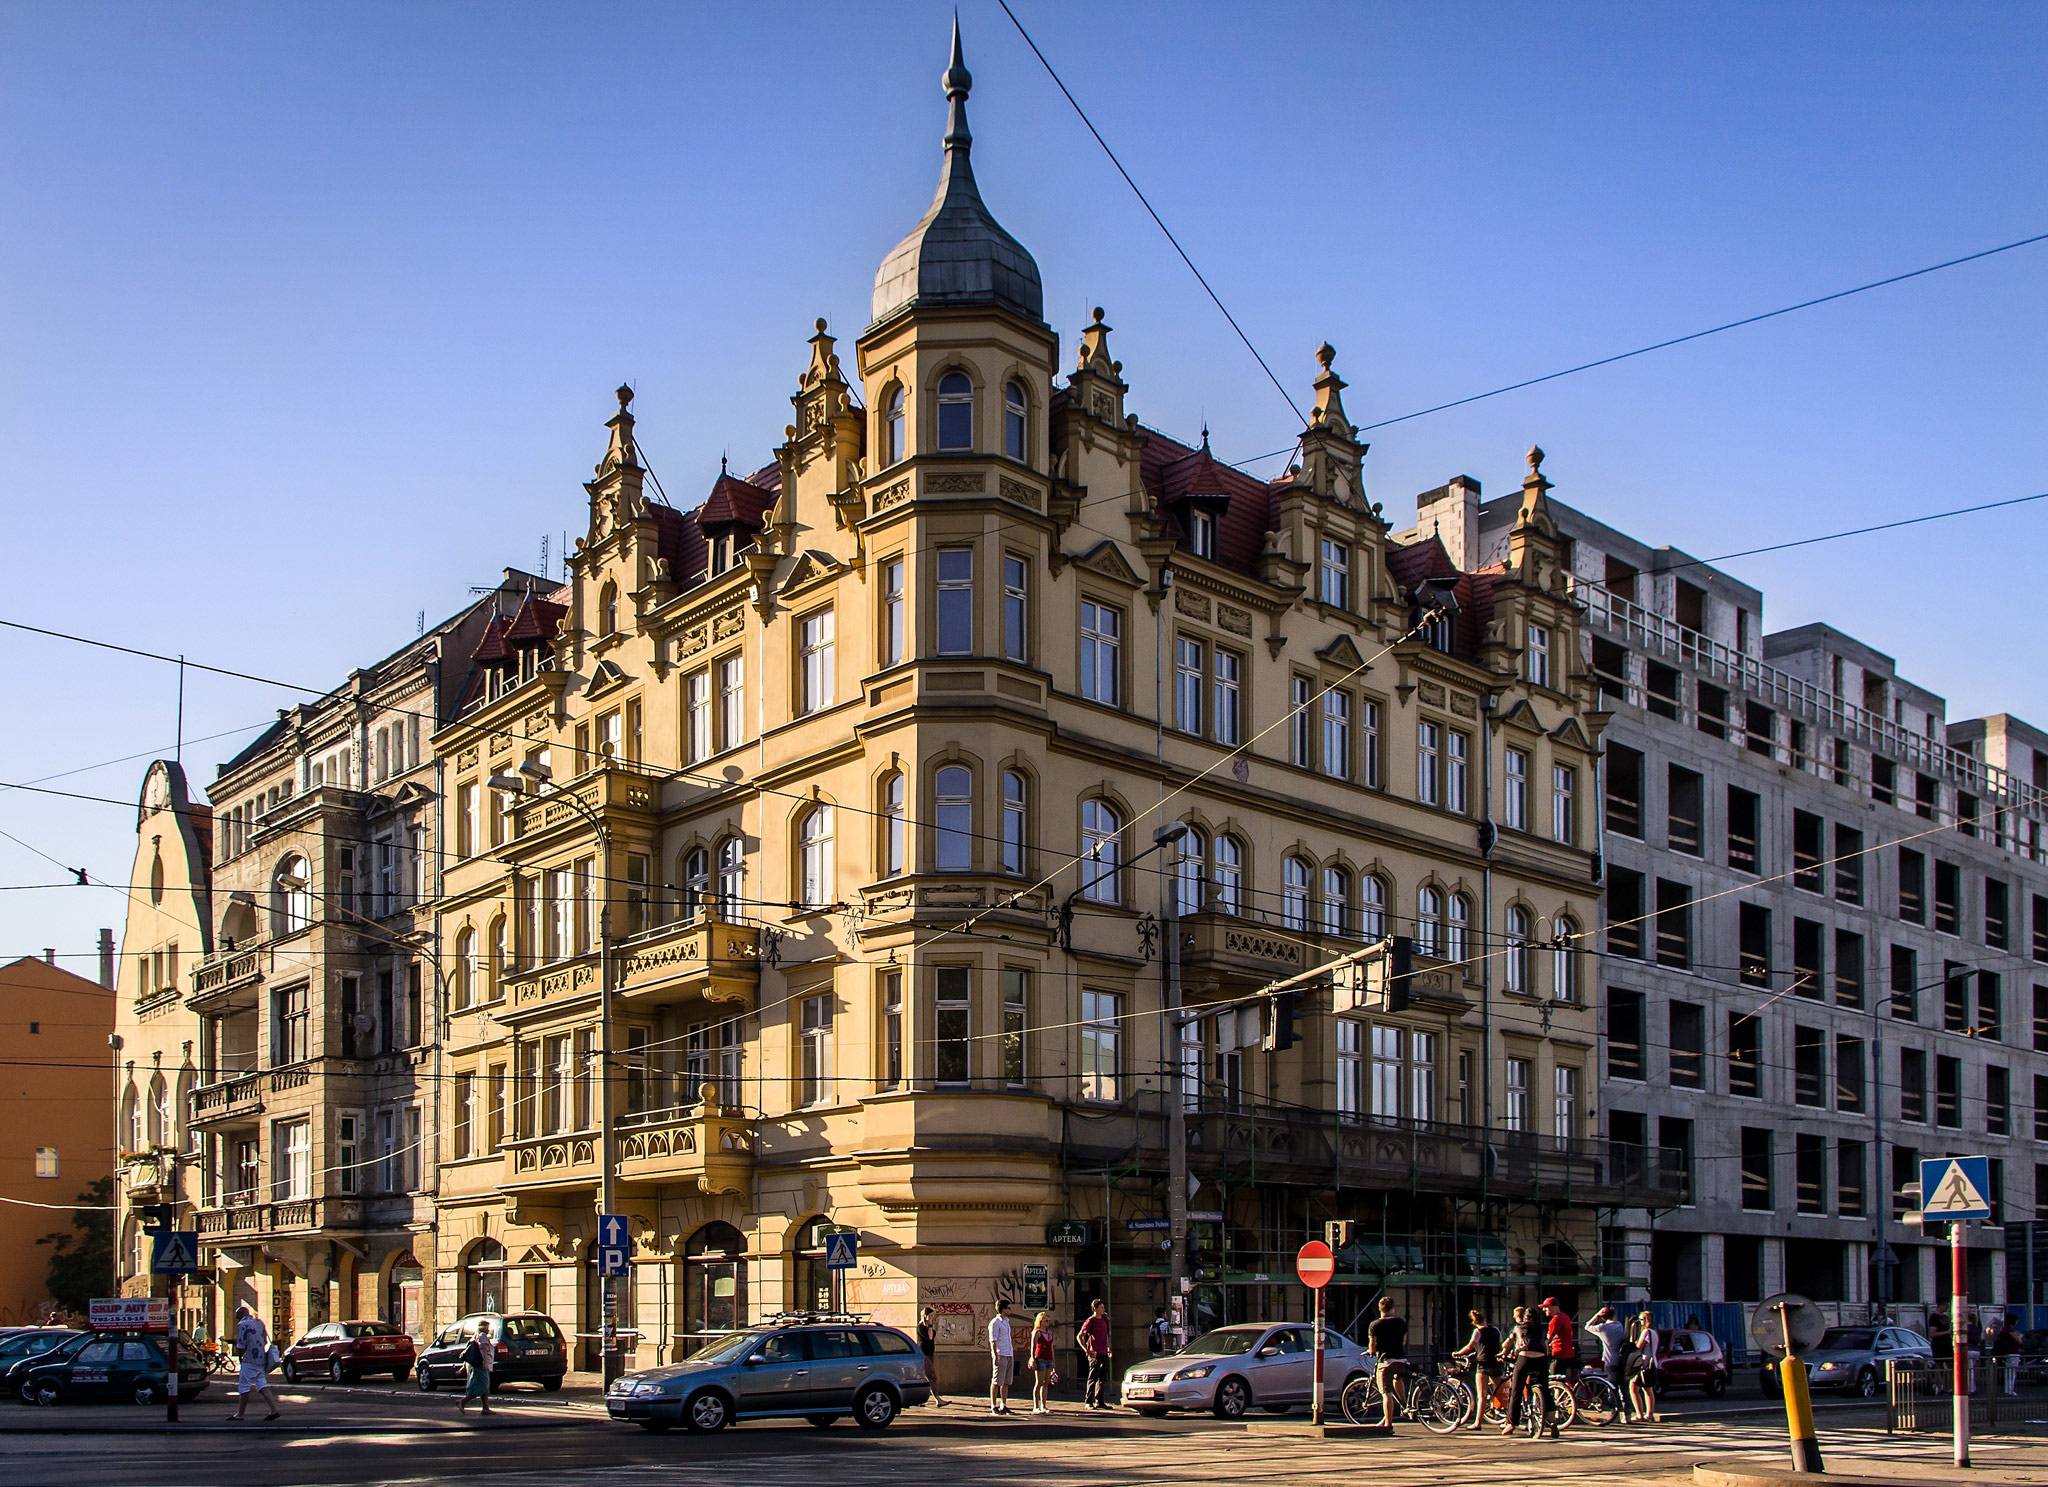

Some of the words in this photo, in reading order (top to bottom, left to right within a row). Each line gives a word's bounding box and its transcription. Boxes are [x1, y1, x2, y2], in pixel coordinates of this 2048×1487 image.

[1053, 1235, 1082, 1243] APTEKA
[606, 1250, 622, 1274] P
[1026, 1267, 1046, 1275] APTEKA
[882, 1283, 906, 1293] APTEKA
[92, 1304, 122, 1313] SKUP
[125, 1303, 146, 1313] AUT
[273, 1289, 281, 1340] MOTORY
